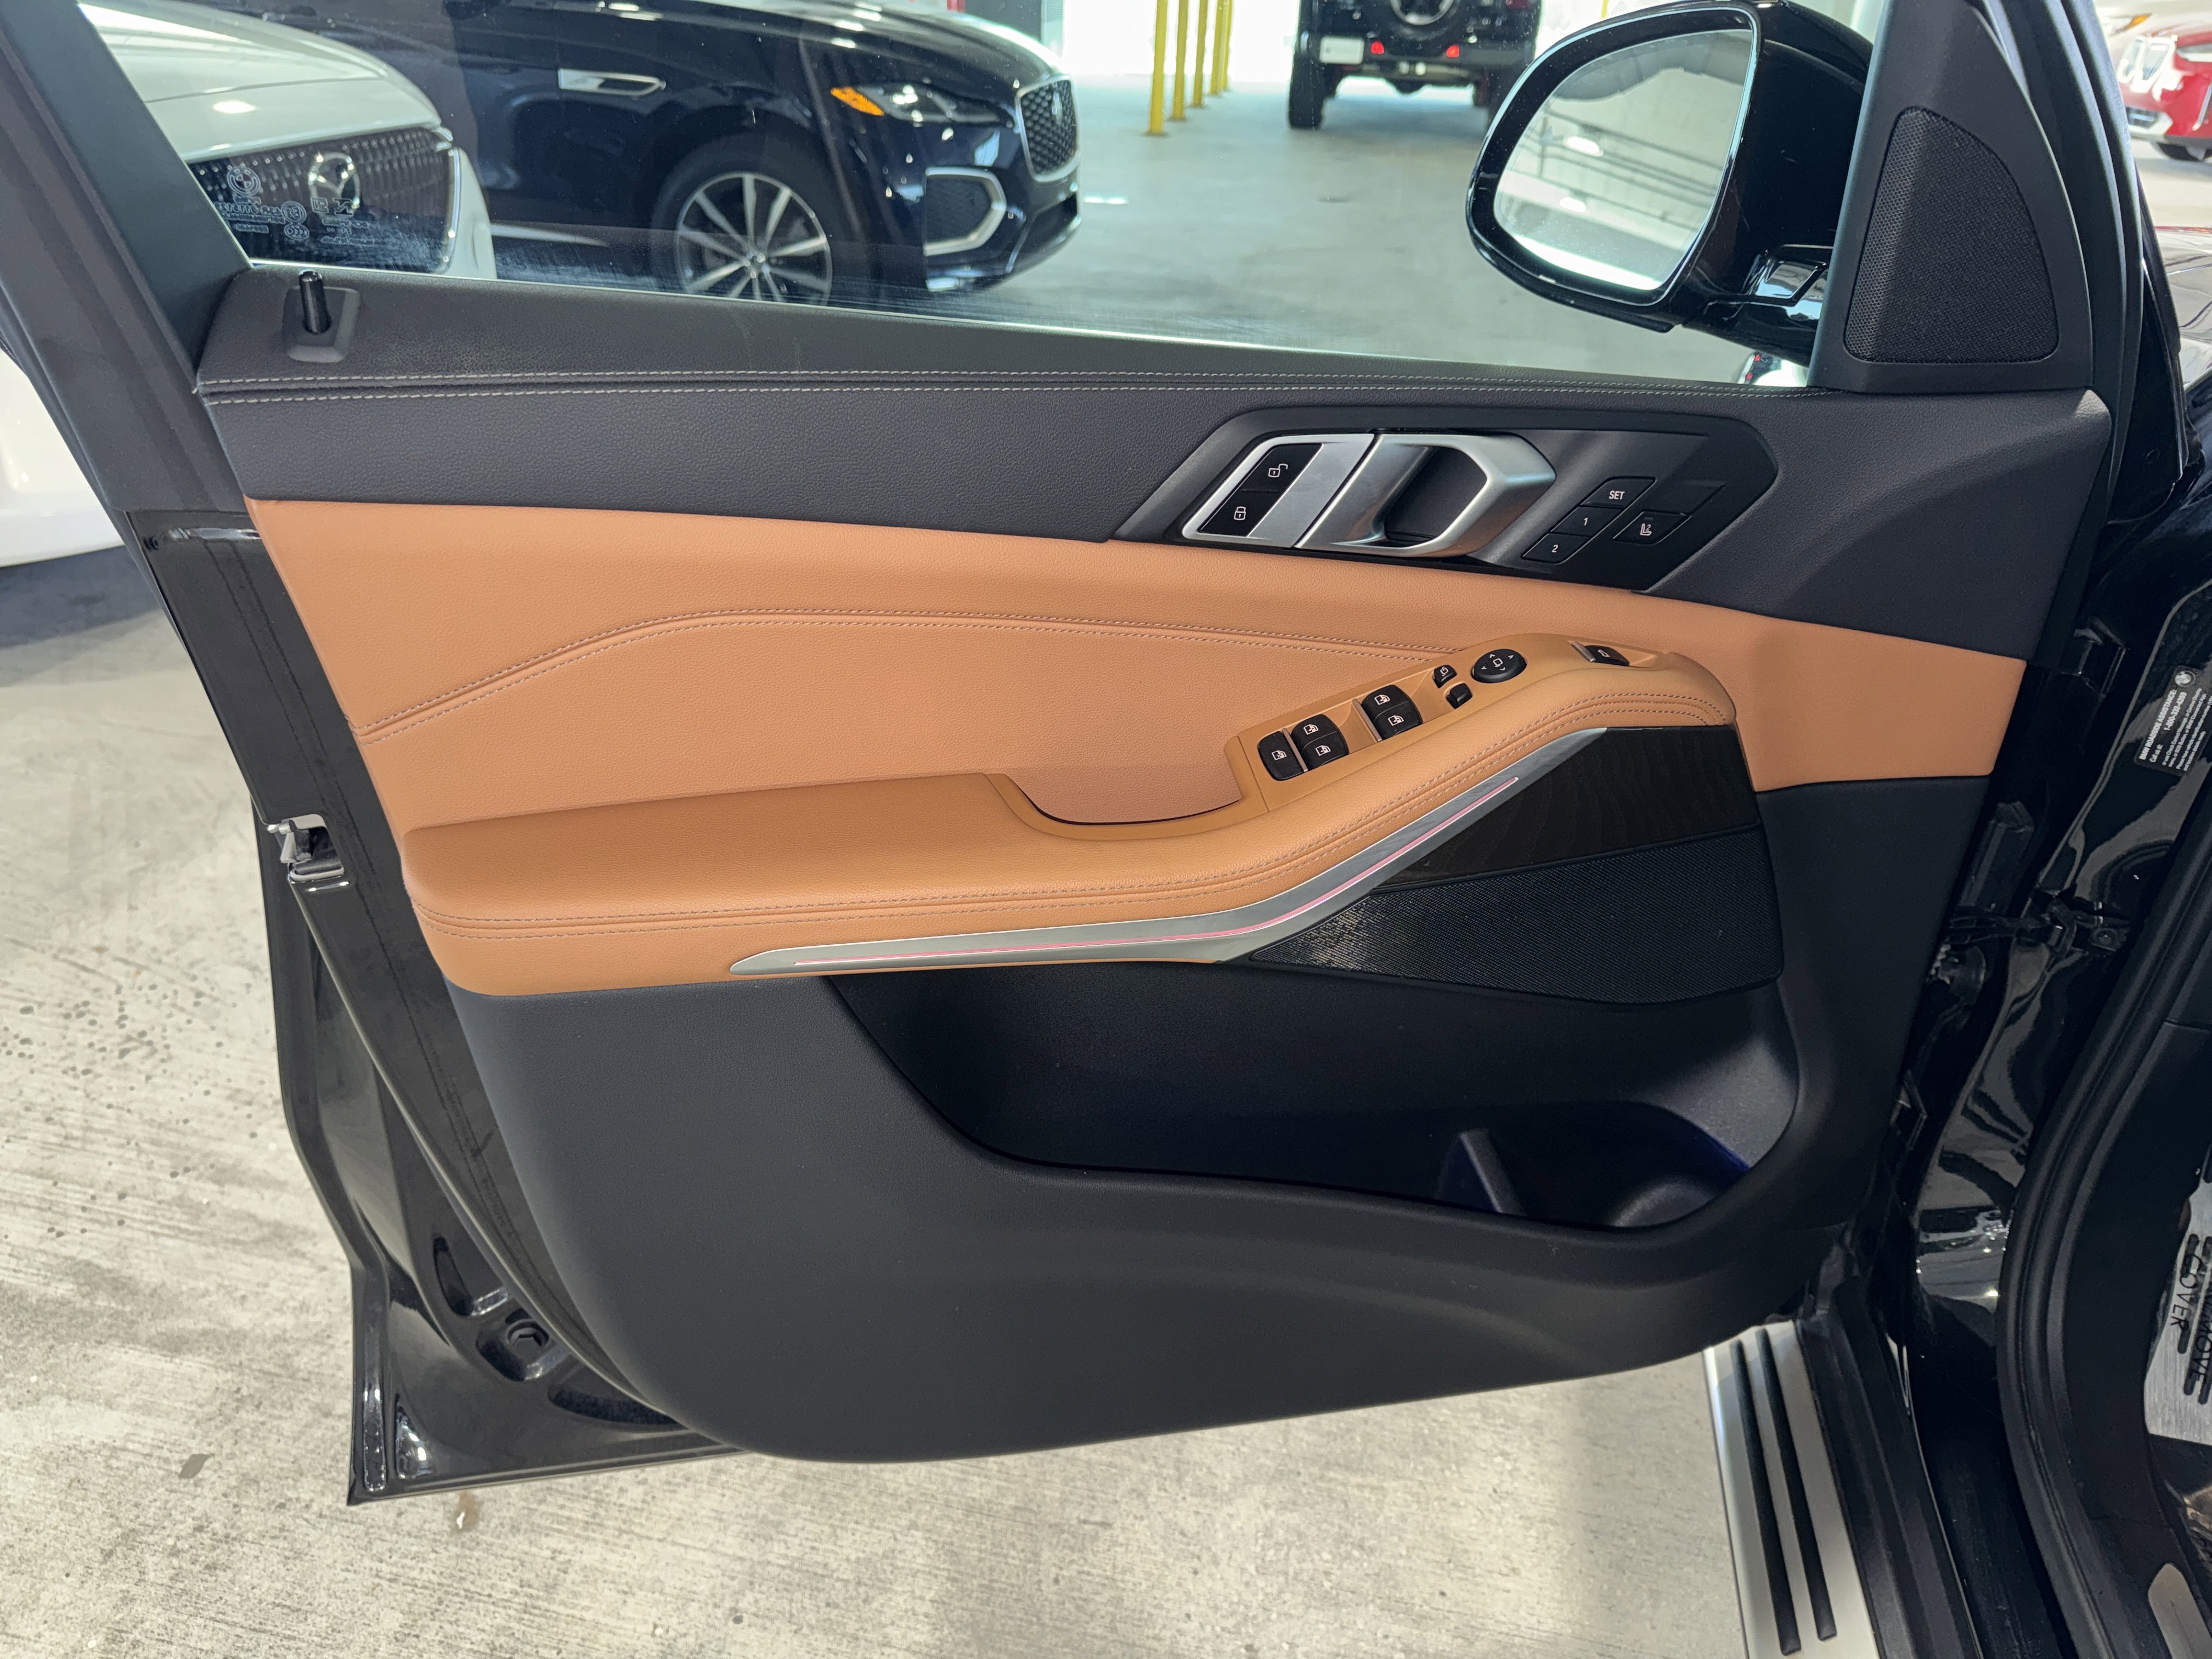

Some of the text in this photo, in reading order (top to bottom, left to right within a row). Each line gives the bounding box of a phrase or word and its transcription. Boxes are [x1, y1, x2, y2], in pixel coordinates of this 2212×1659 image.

[1609, 490, 1625, 500] SET
[1583, 517, 1588, 526] 1
[1551, 544, 1559, 553] 2
[2170, 1254, 2203, 1330] COVER
